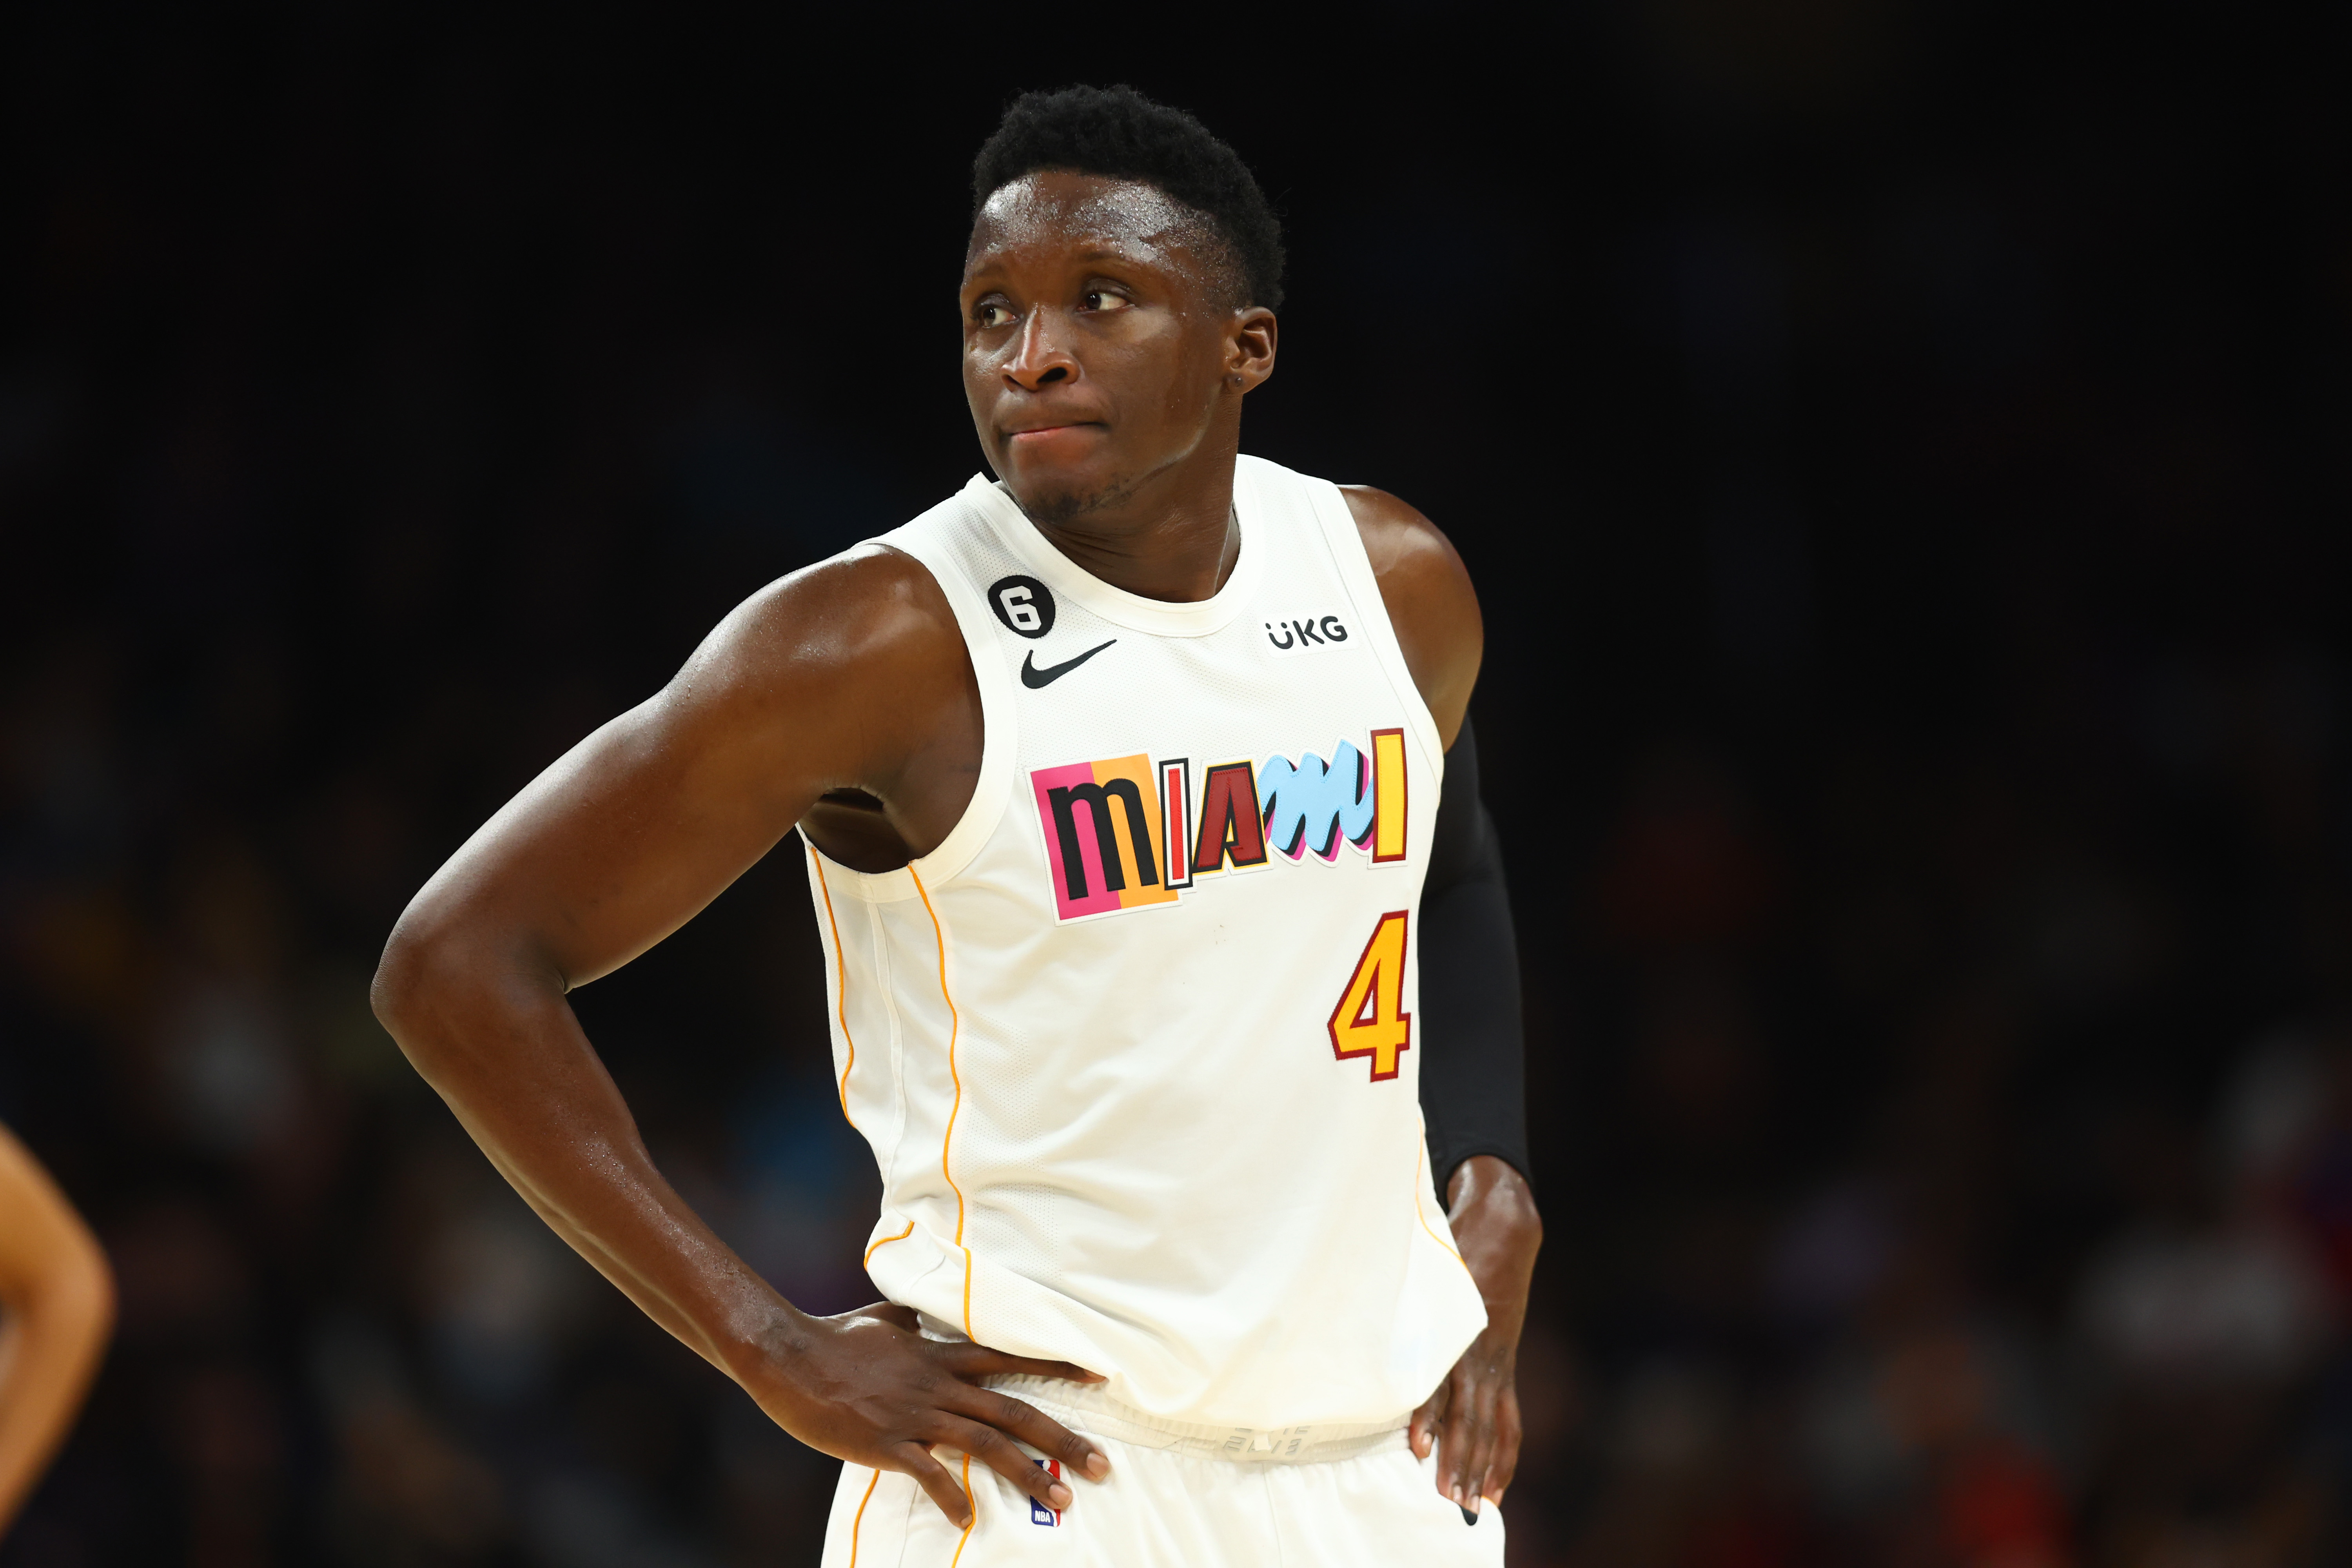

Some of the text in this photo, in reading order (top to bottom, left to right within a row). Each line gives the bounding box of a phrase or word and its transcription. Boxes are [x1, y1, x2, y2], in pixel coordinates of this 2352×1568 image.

[999, 586, 1042, 630] 6
[1327, 909, 1410, 1082] 4
[1035, 1510, 1050, 1523] NBA
